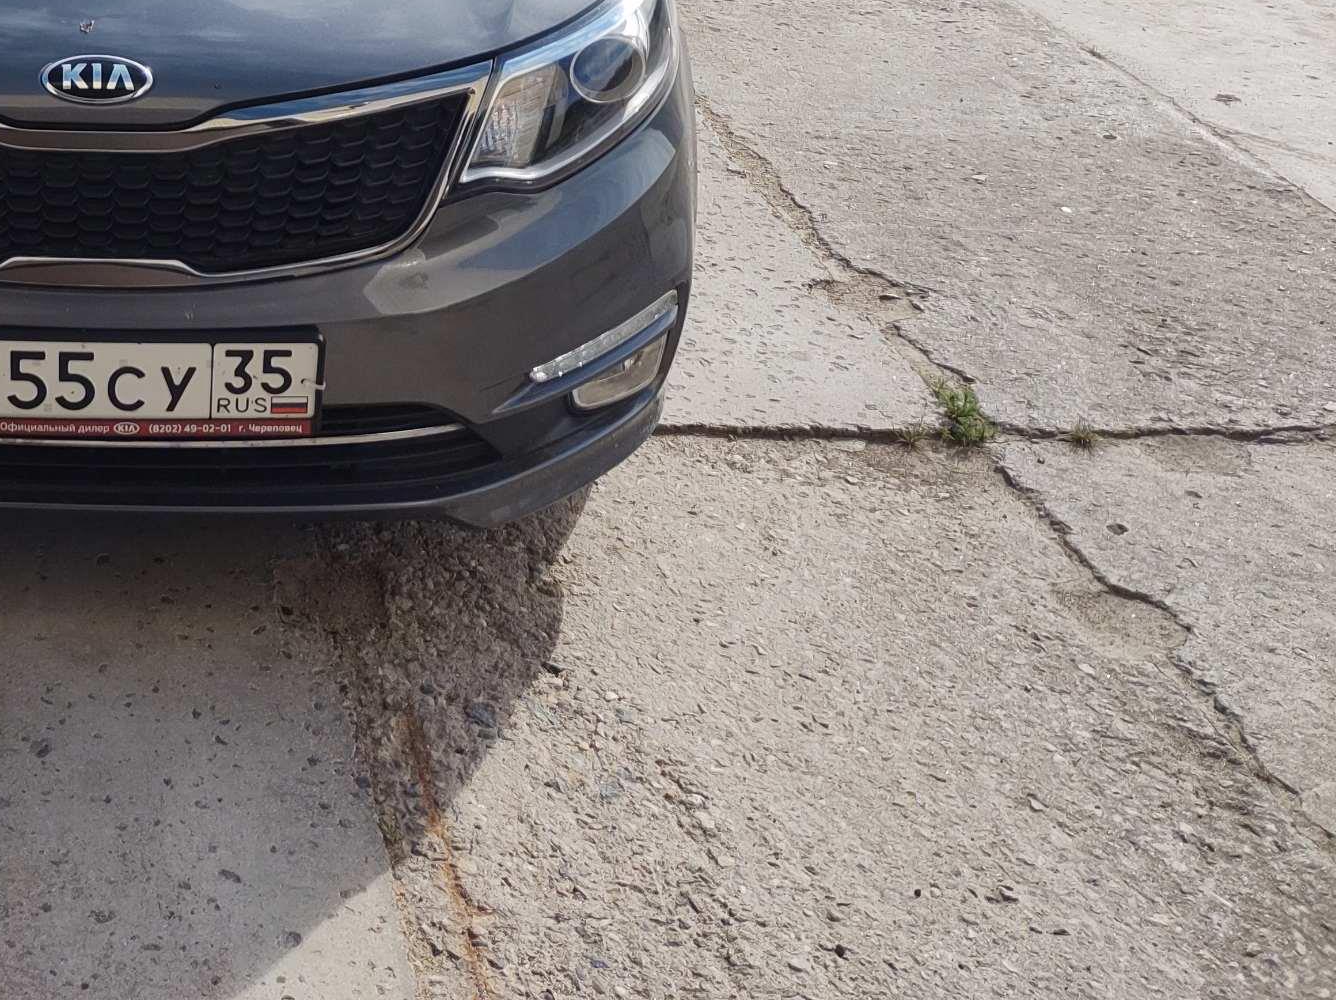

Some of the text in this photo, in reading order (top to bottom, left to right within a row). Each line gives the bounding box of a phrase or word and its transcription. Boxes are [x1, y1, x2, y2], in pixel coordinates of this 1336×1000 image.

[61, 62, 135, 91] KIA
[224, 349, 293, 396] 35
[216, 397, 268, 413] RUS
[0, 421, 76, 434] Официальный
[148, 423, 182, 434] (8202)
